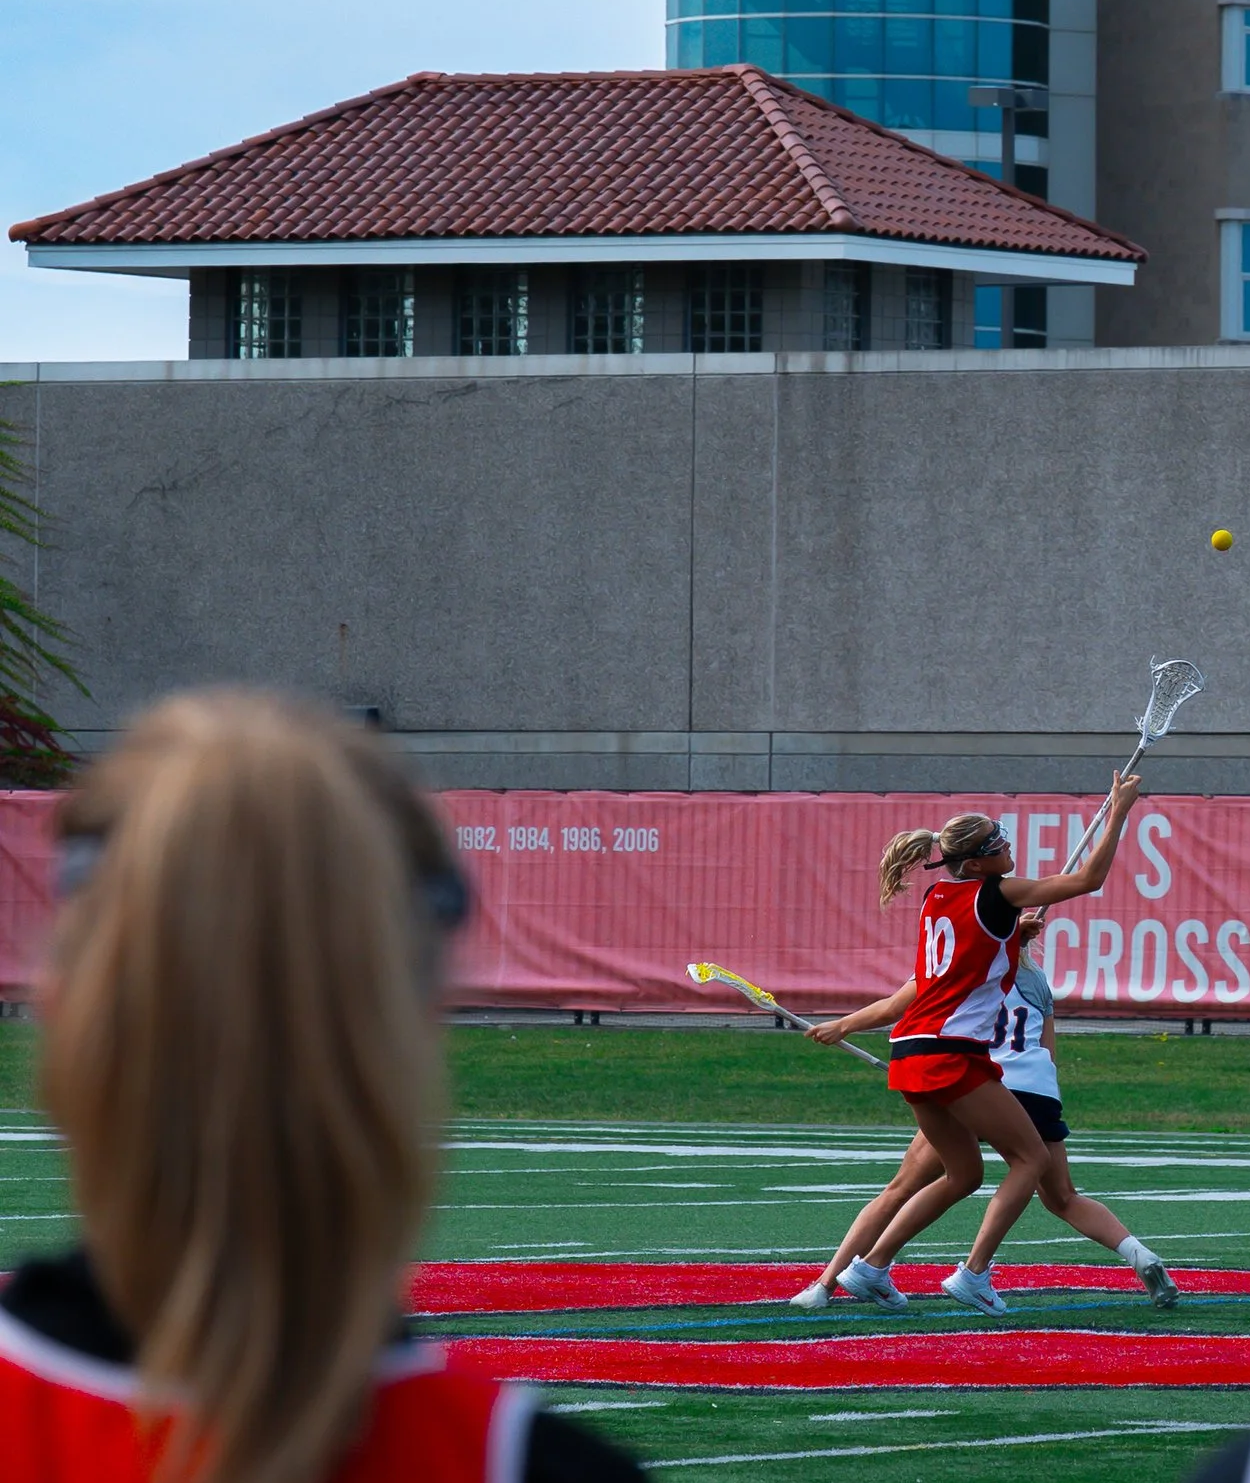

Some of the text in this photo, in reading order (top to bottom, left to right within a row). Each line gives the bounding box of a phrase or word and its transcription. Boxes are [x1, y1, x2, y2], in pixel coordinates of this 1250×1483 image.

[456, 826, 660, 854] 1982, 1984, 1986, 2006
[925, 916, 956, 979] 10
